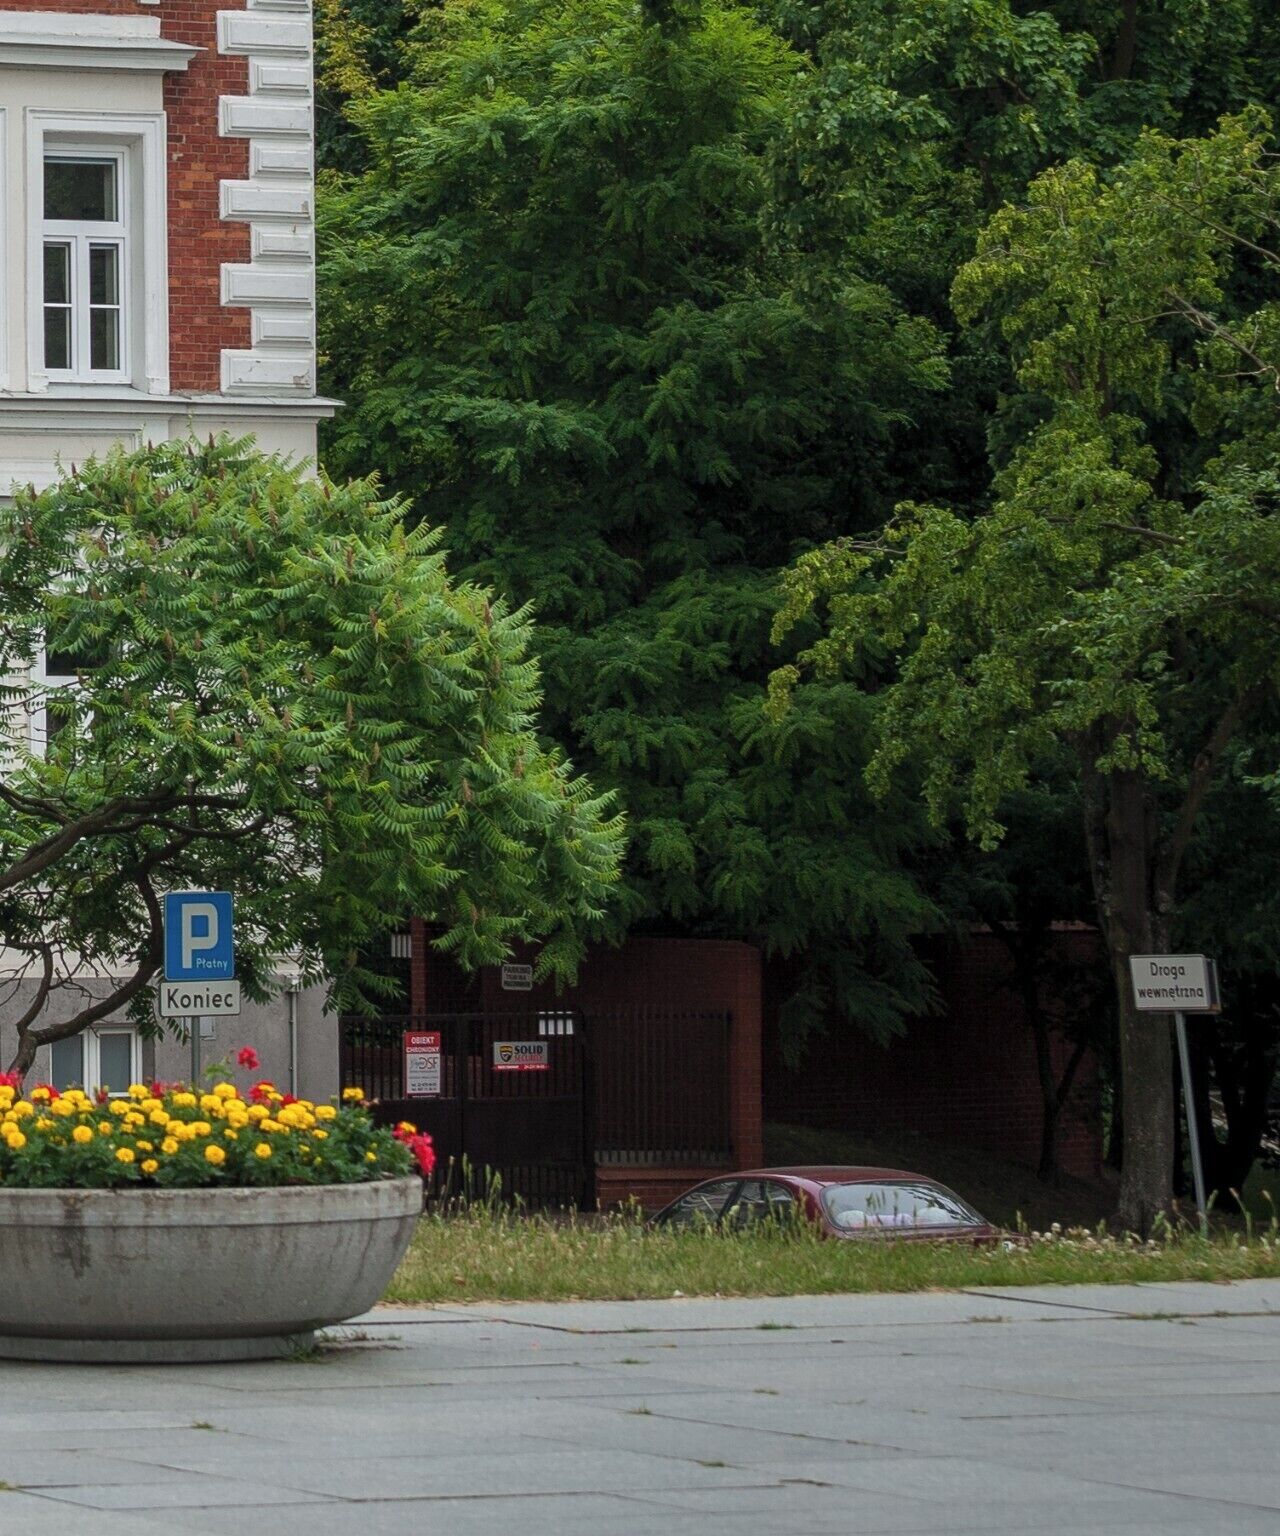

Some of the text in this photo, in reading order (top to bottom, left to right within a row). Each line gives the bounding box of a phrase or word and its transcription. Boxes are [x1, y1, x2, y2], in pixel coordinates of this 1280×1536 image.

[182, 903, 218, 969] P
[196, 958, 228, 971] Płatny
[1150, 962, 1186, 979] Droga
[167, 987, 233, 1009] Koniec
[1137, 985, 1204, 1001] wewnętrzna
[411, 1036, 435, 1044] OBIEKT
[514, 1045, 543, 1054] SOLID
